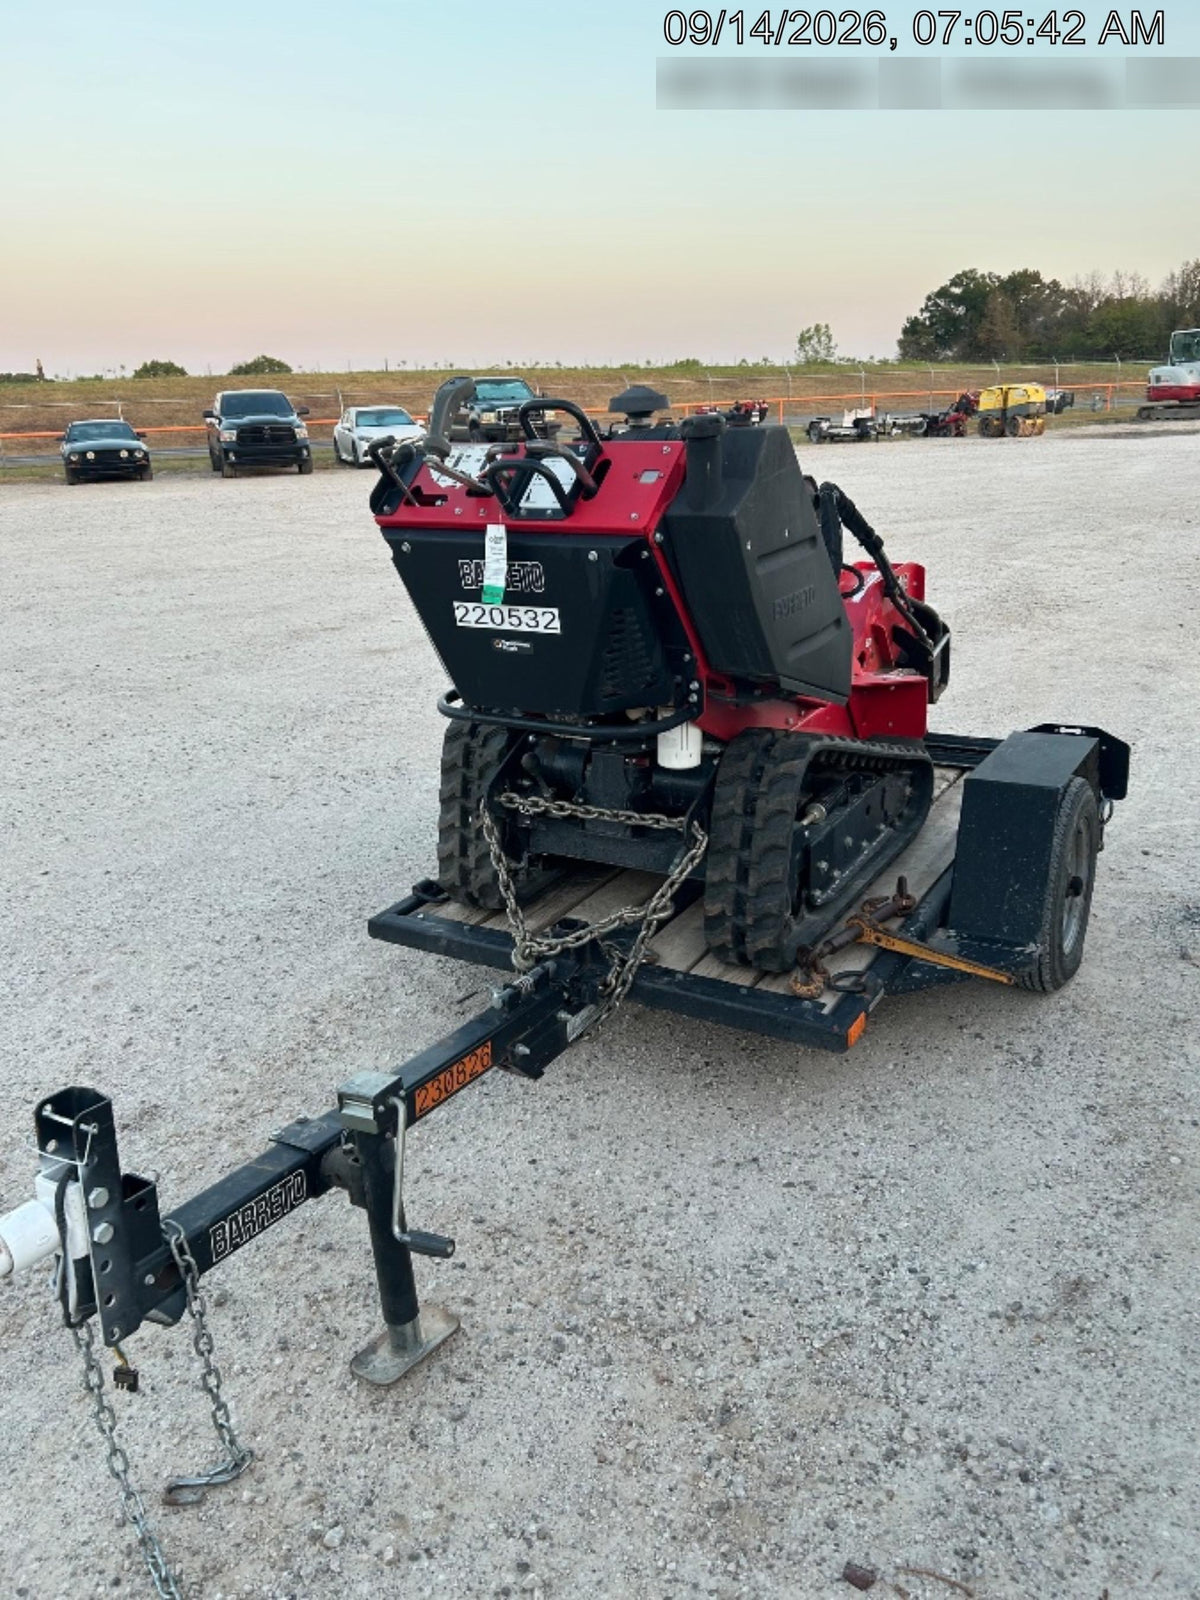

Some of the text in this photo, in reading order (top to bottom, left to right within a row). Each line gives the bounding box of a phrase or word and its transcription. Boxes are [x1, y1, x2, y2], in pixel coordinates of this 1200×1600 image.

[458, 559, 545, 592] BAETO
[456, 604, 558, 630] 220532
[415, 1044, 491, 1112] 230826
[209, 1169, 307, 1263] BARRETO
